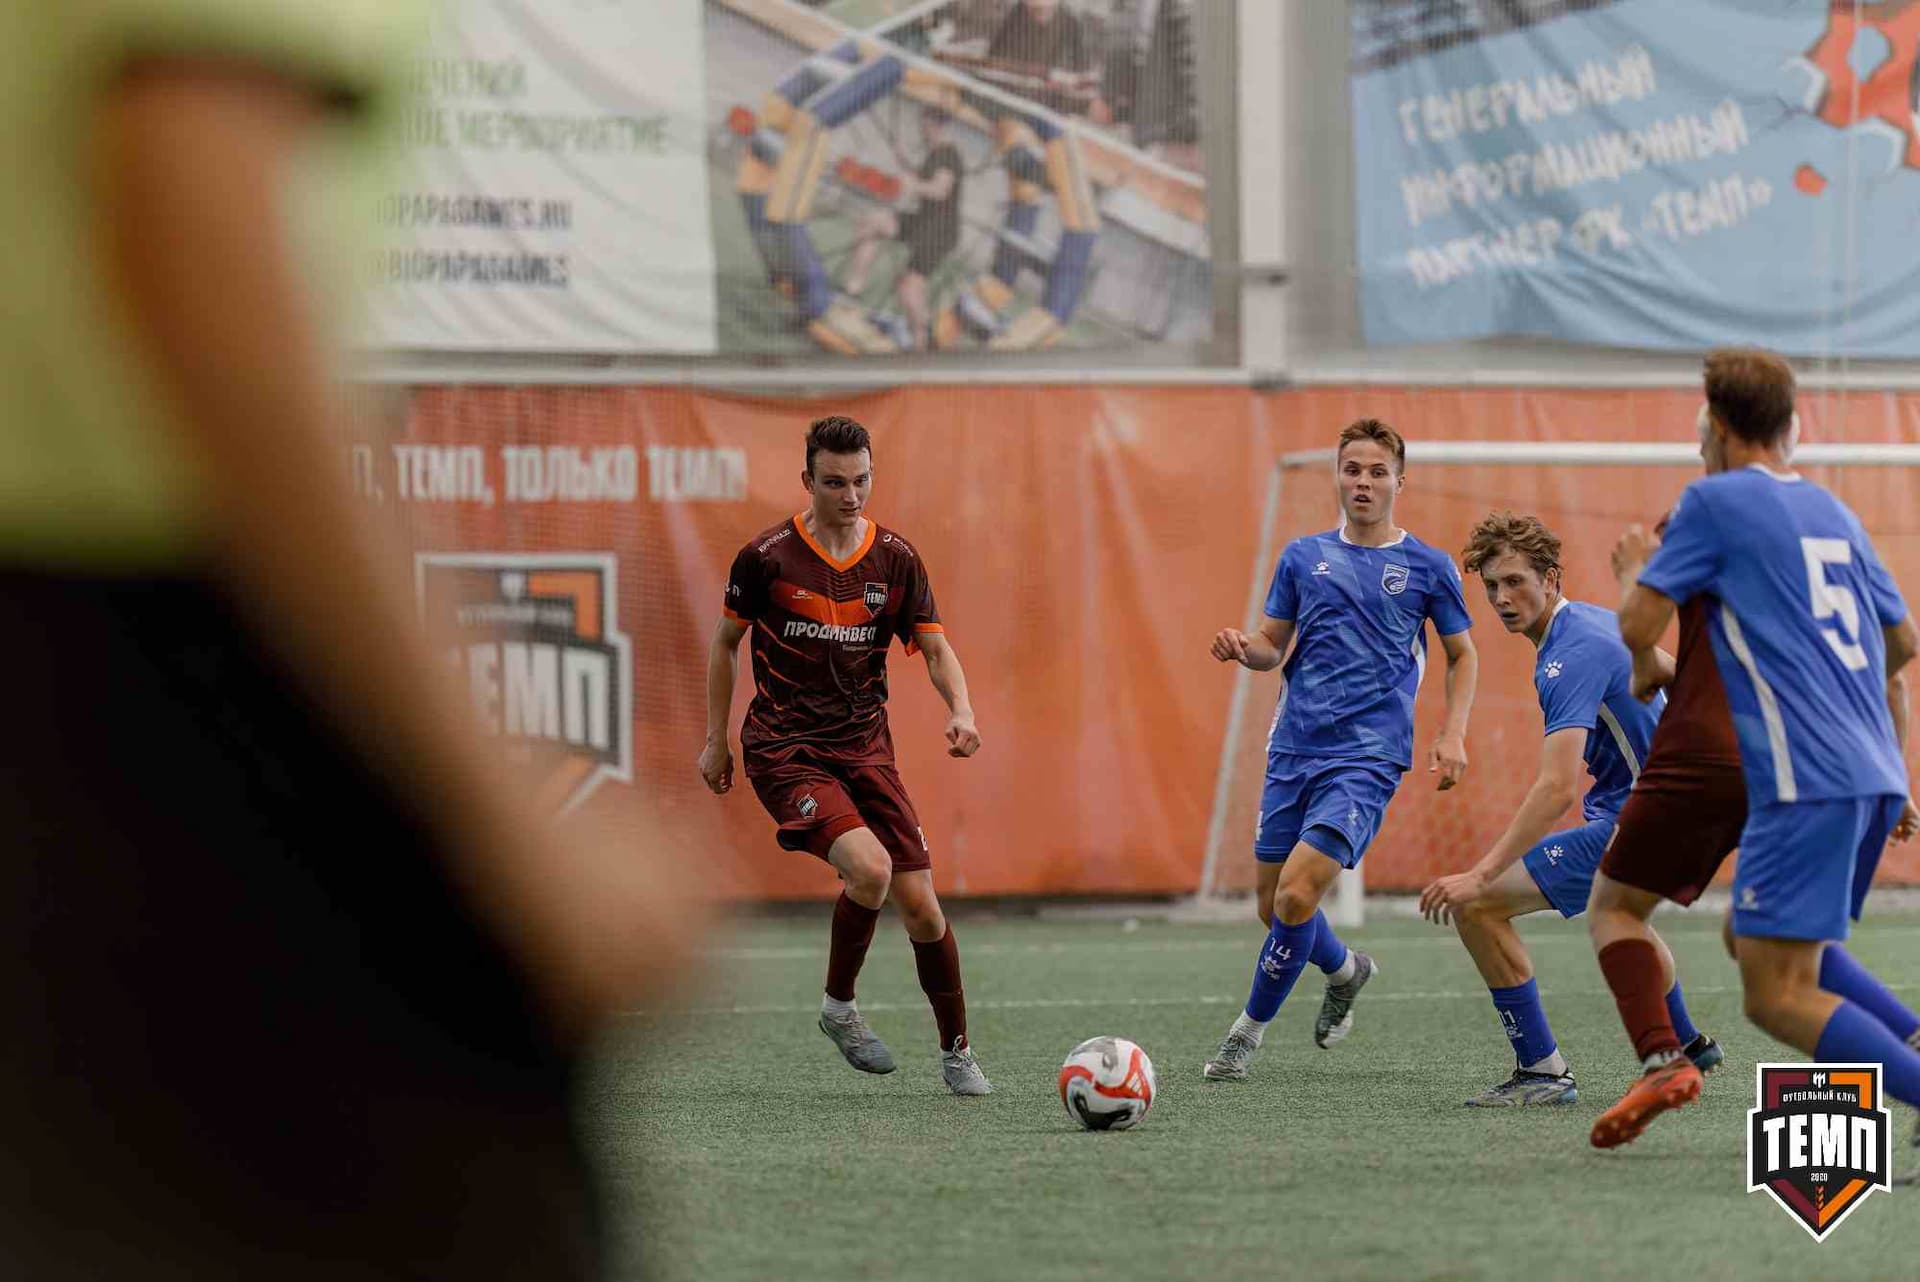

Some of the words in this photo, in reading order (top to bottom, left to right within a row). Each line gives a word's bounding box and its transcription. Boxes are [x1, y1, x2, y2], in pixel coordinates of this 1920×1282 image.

[1399, 43, 1657, 145] ГЕНЕРАЛЬНЫЙ
[392, 444, 495, 507] ТЕМП,
[502, 444, 640, 501] ТОЛЬКО
[1801, 537, 1868, 671] 5
[450, 641, 611, 751] ЕМП
[1270, 936, 1291, 961] 14
